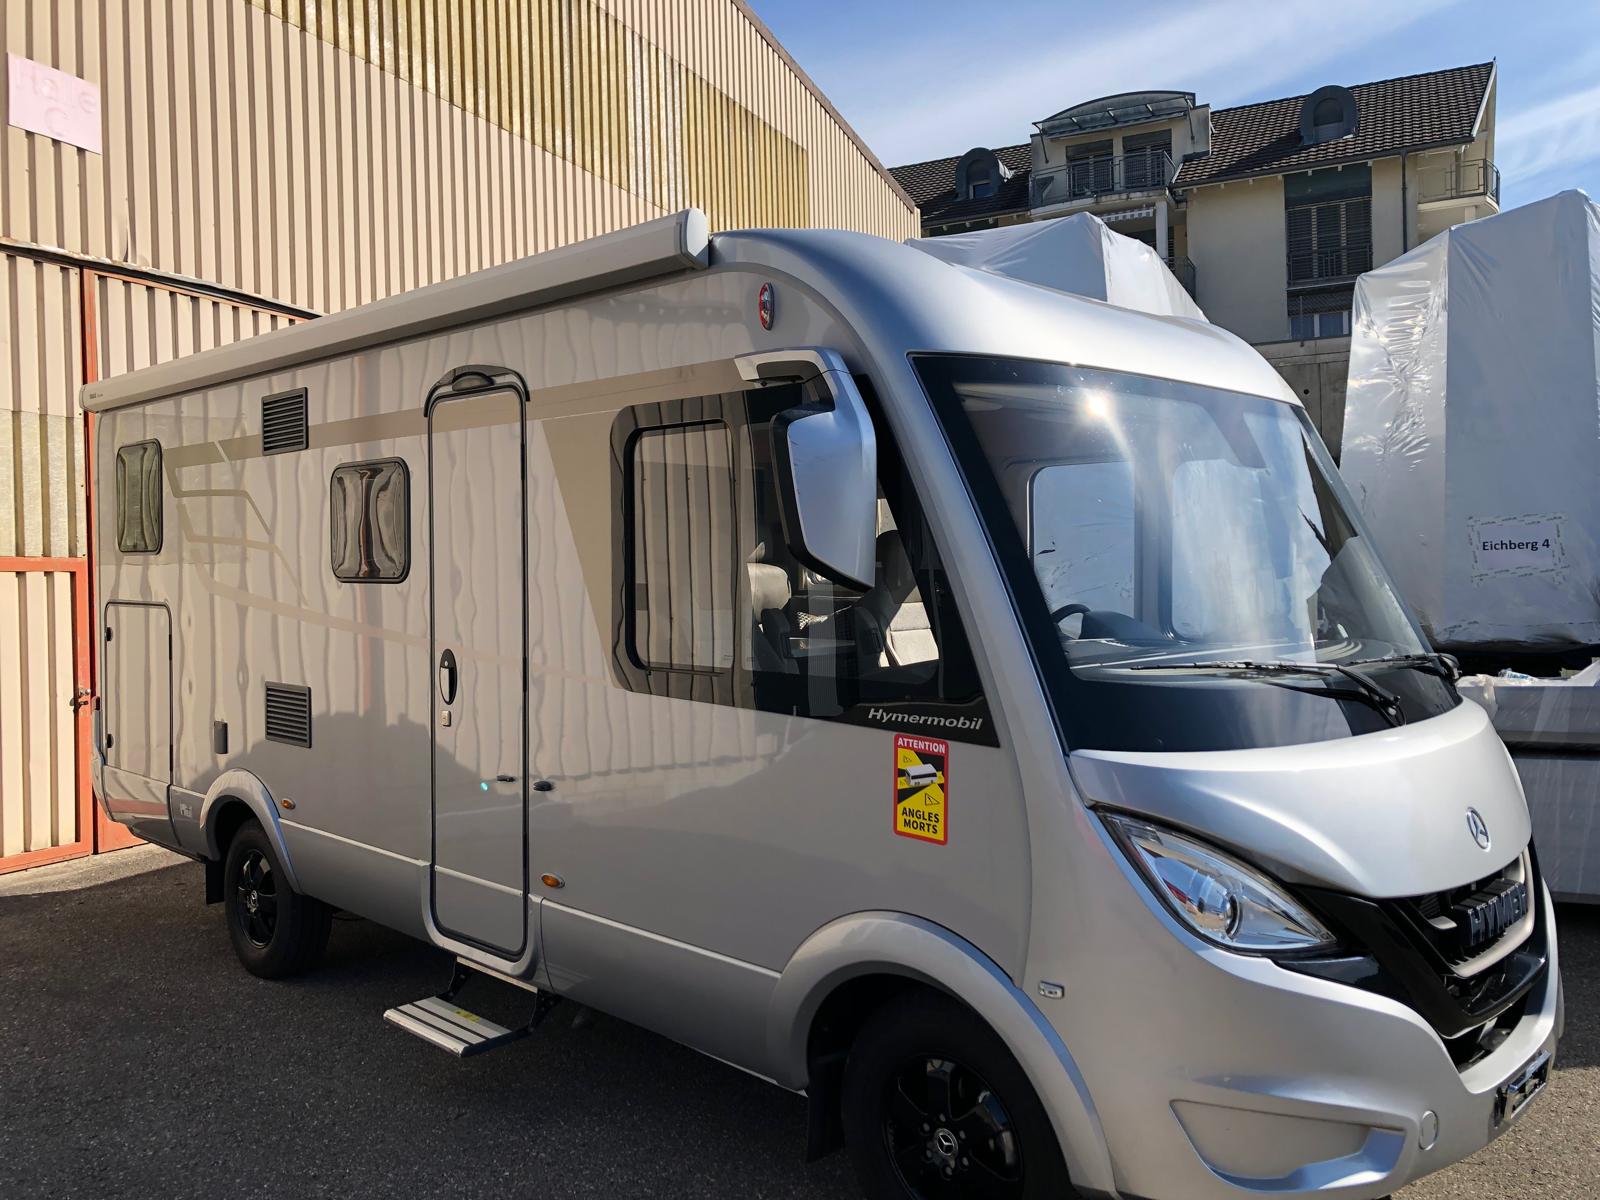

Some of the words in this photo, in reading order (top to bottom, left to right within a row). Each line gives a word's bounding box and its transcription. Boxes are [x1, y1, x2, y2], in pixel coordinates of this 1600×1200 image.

[1482, 540, 1538, 551] Eichberg
[1542, 538, 1551, 549] 4
[868, 708, 983, 730] Hymermobil
[898, 737, 946, 754] ATTENTION
[902, 807, 940, 823] ANGLES
[903, 818, 938, 834] MORTS
